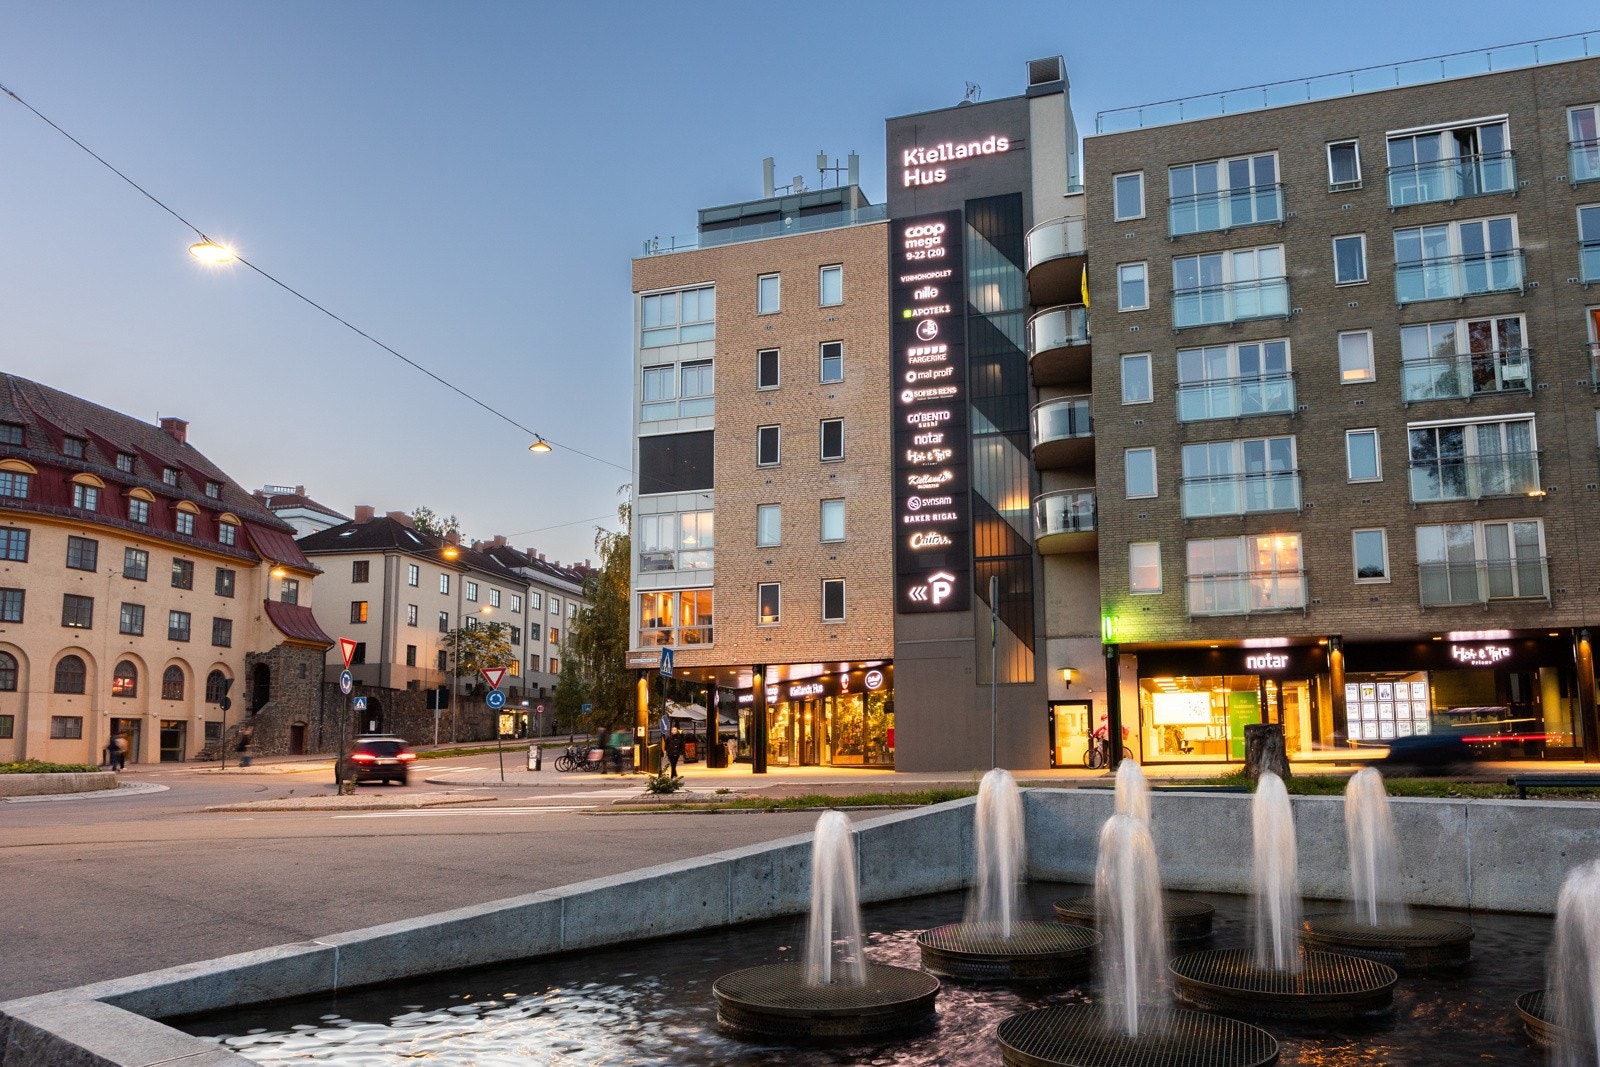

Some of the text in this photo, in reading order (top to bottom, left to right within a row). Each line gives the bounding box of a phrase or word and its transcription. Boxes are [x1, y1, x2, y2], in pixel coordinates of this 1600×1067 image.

[904, 136, 1009, 166] Kiellands
[904, 169, 946, 187] Hus
[905, 224, 945, 237] coop
[905, 236, 941, 248] mega
[906, 248, 945, 260] 9-22 (20)
[901, 270, 952, 282] VINMONOPOLET
[914, 287, 938, 299] nille
[912, 306, 944, 316] APOTEK
[909, 354, 947, 364] FARGERIKE
[933, 367, 954, 379] proff
[938, 387, 957, 395] RENS
[914, 432, 944, 445] notar
[922, 497, 952, 506] SYNSAM
[904, 513, 957, 523] BAKER RIGAL
[932, 581, 951, 604] P
[1246, 653, 1289, 669] notar
